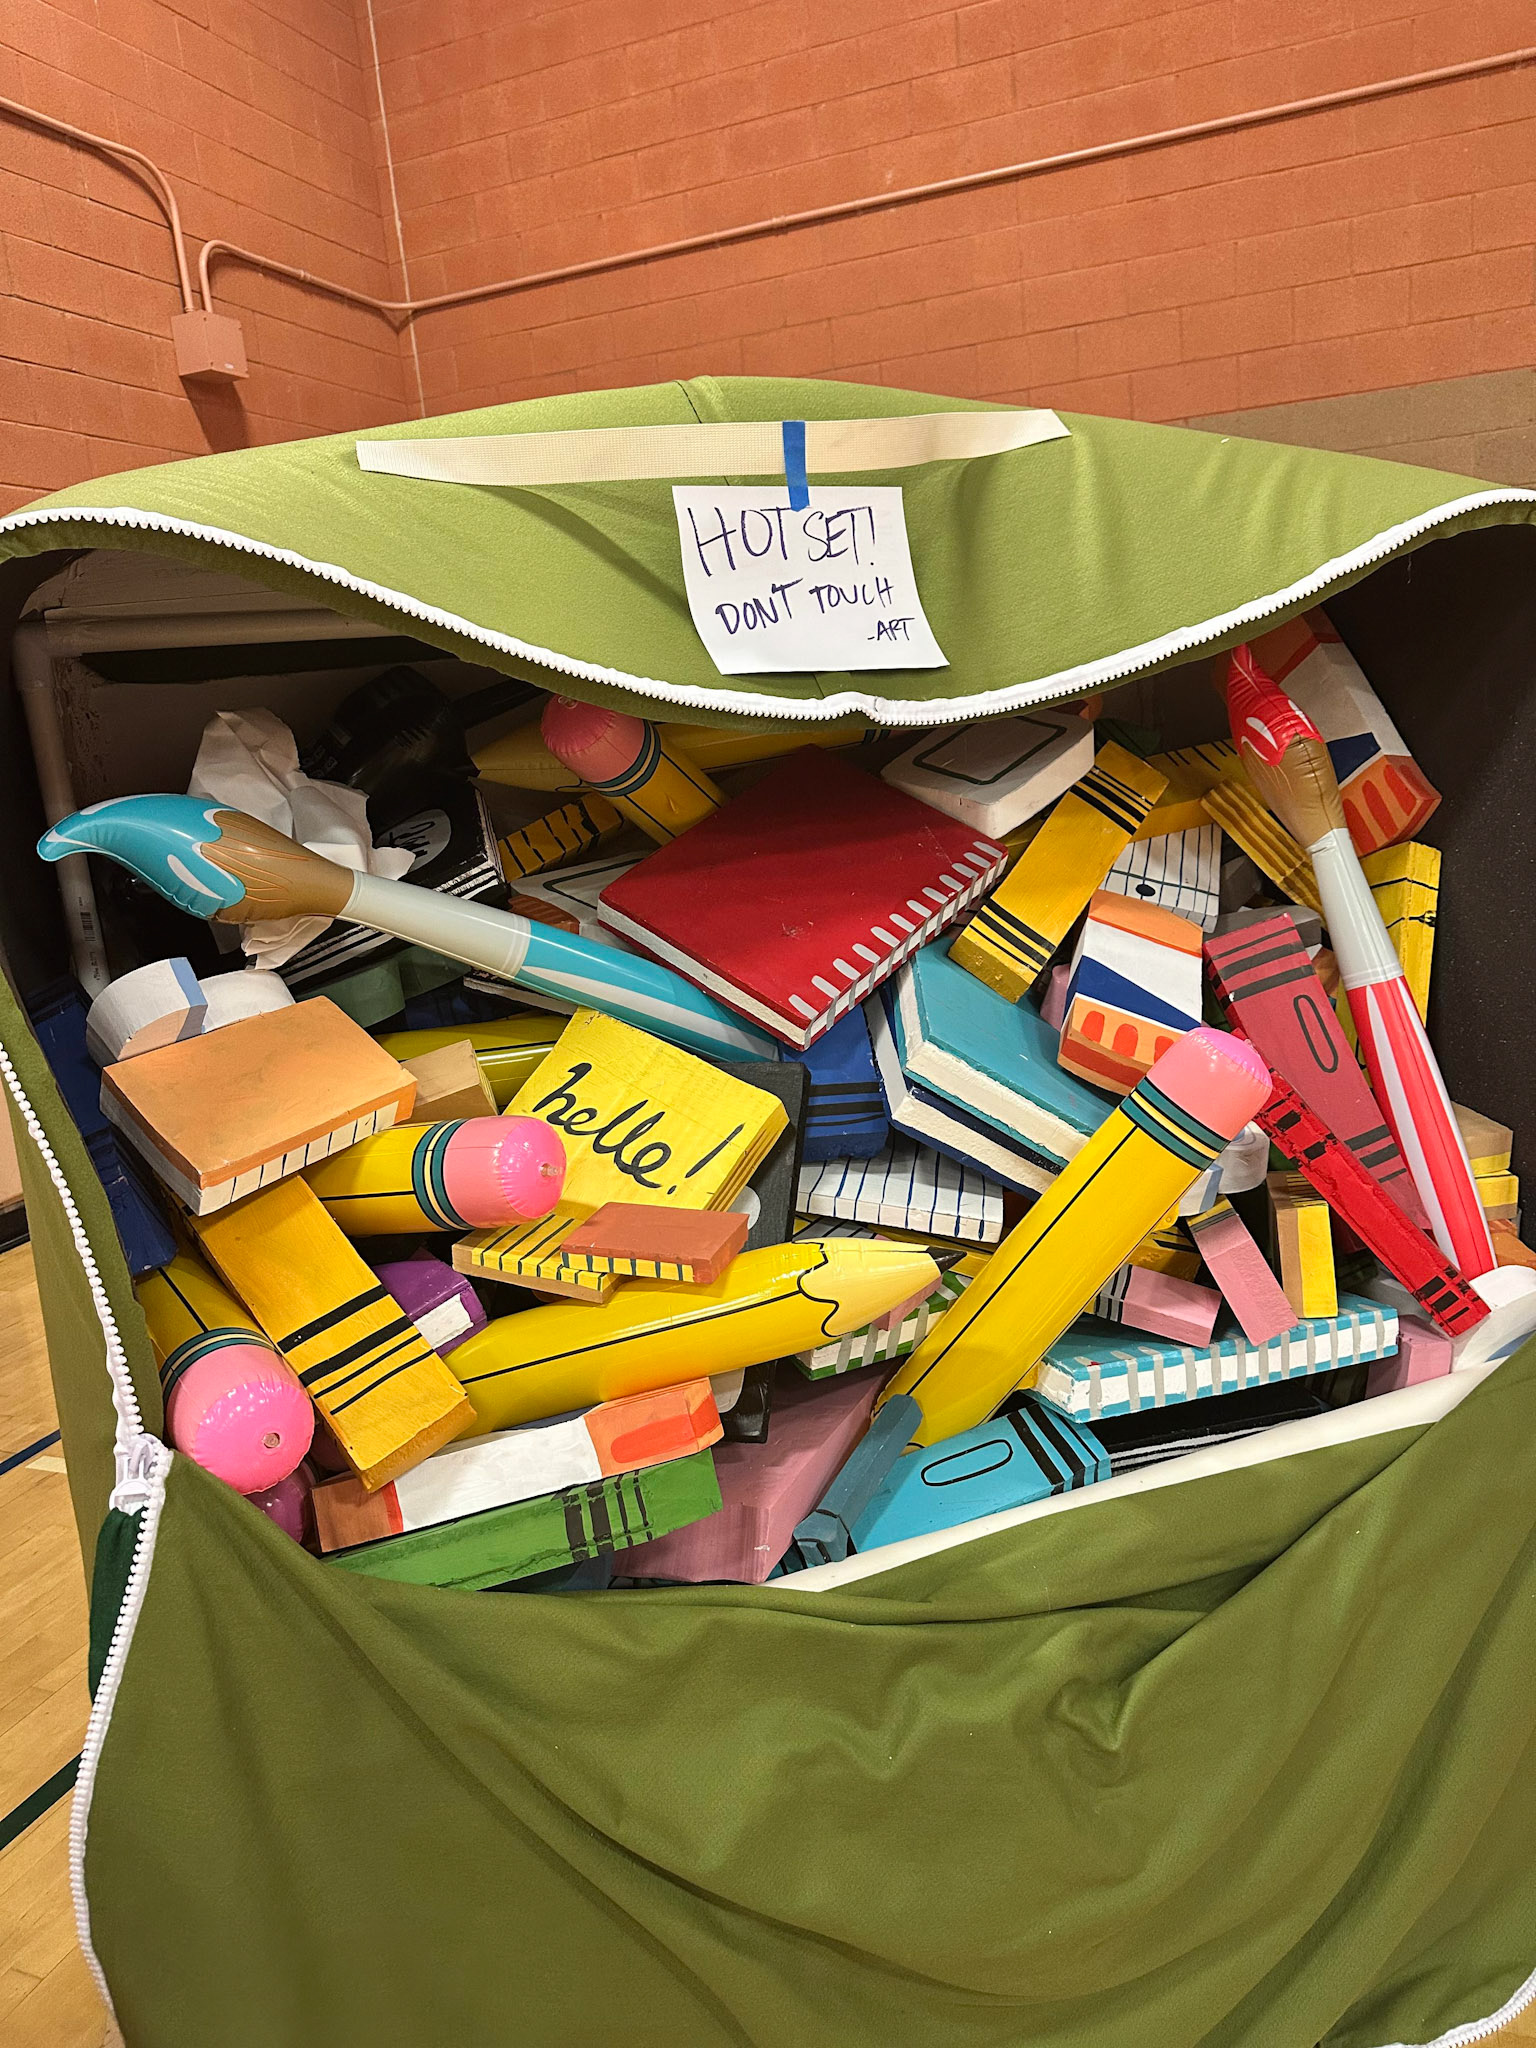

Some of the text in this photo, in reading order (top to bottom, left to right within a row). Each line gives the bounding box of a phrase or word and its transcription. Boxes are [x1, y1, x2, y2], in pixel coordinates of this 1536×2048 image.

[687, 506, 876, 577] HOT SET!
[808, 576, 895, 614] TOUCH
